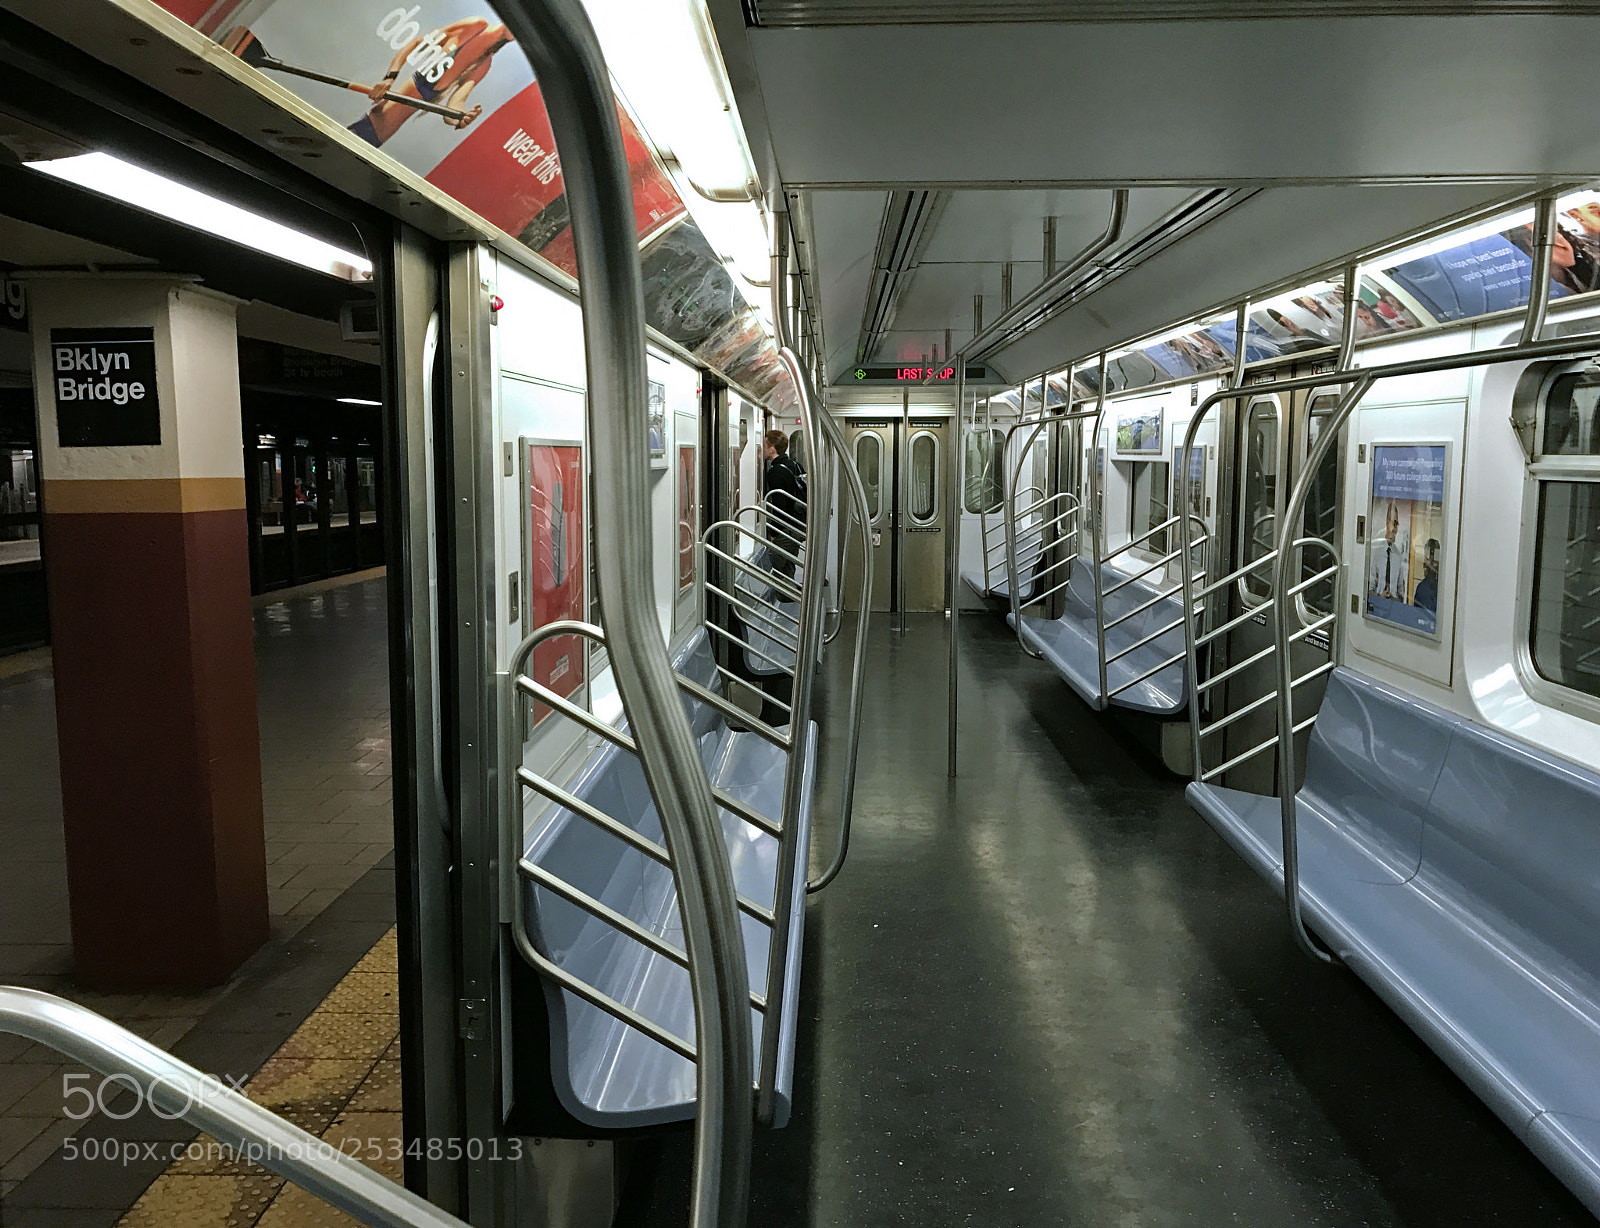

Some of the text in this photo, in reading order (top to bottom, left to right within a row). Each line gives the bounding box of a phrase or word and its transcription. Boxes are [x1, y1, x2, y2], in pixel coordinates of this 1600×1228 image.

[376, 4, 456, 84] do this
[503, 128, 562, 185] wear this
[55, 347, 131, 375] Bklyn
[897, 368, 923, 380] LAST
[926, 367, 954, 380] SOP
[58, 377, 146, 405] Bridge
